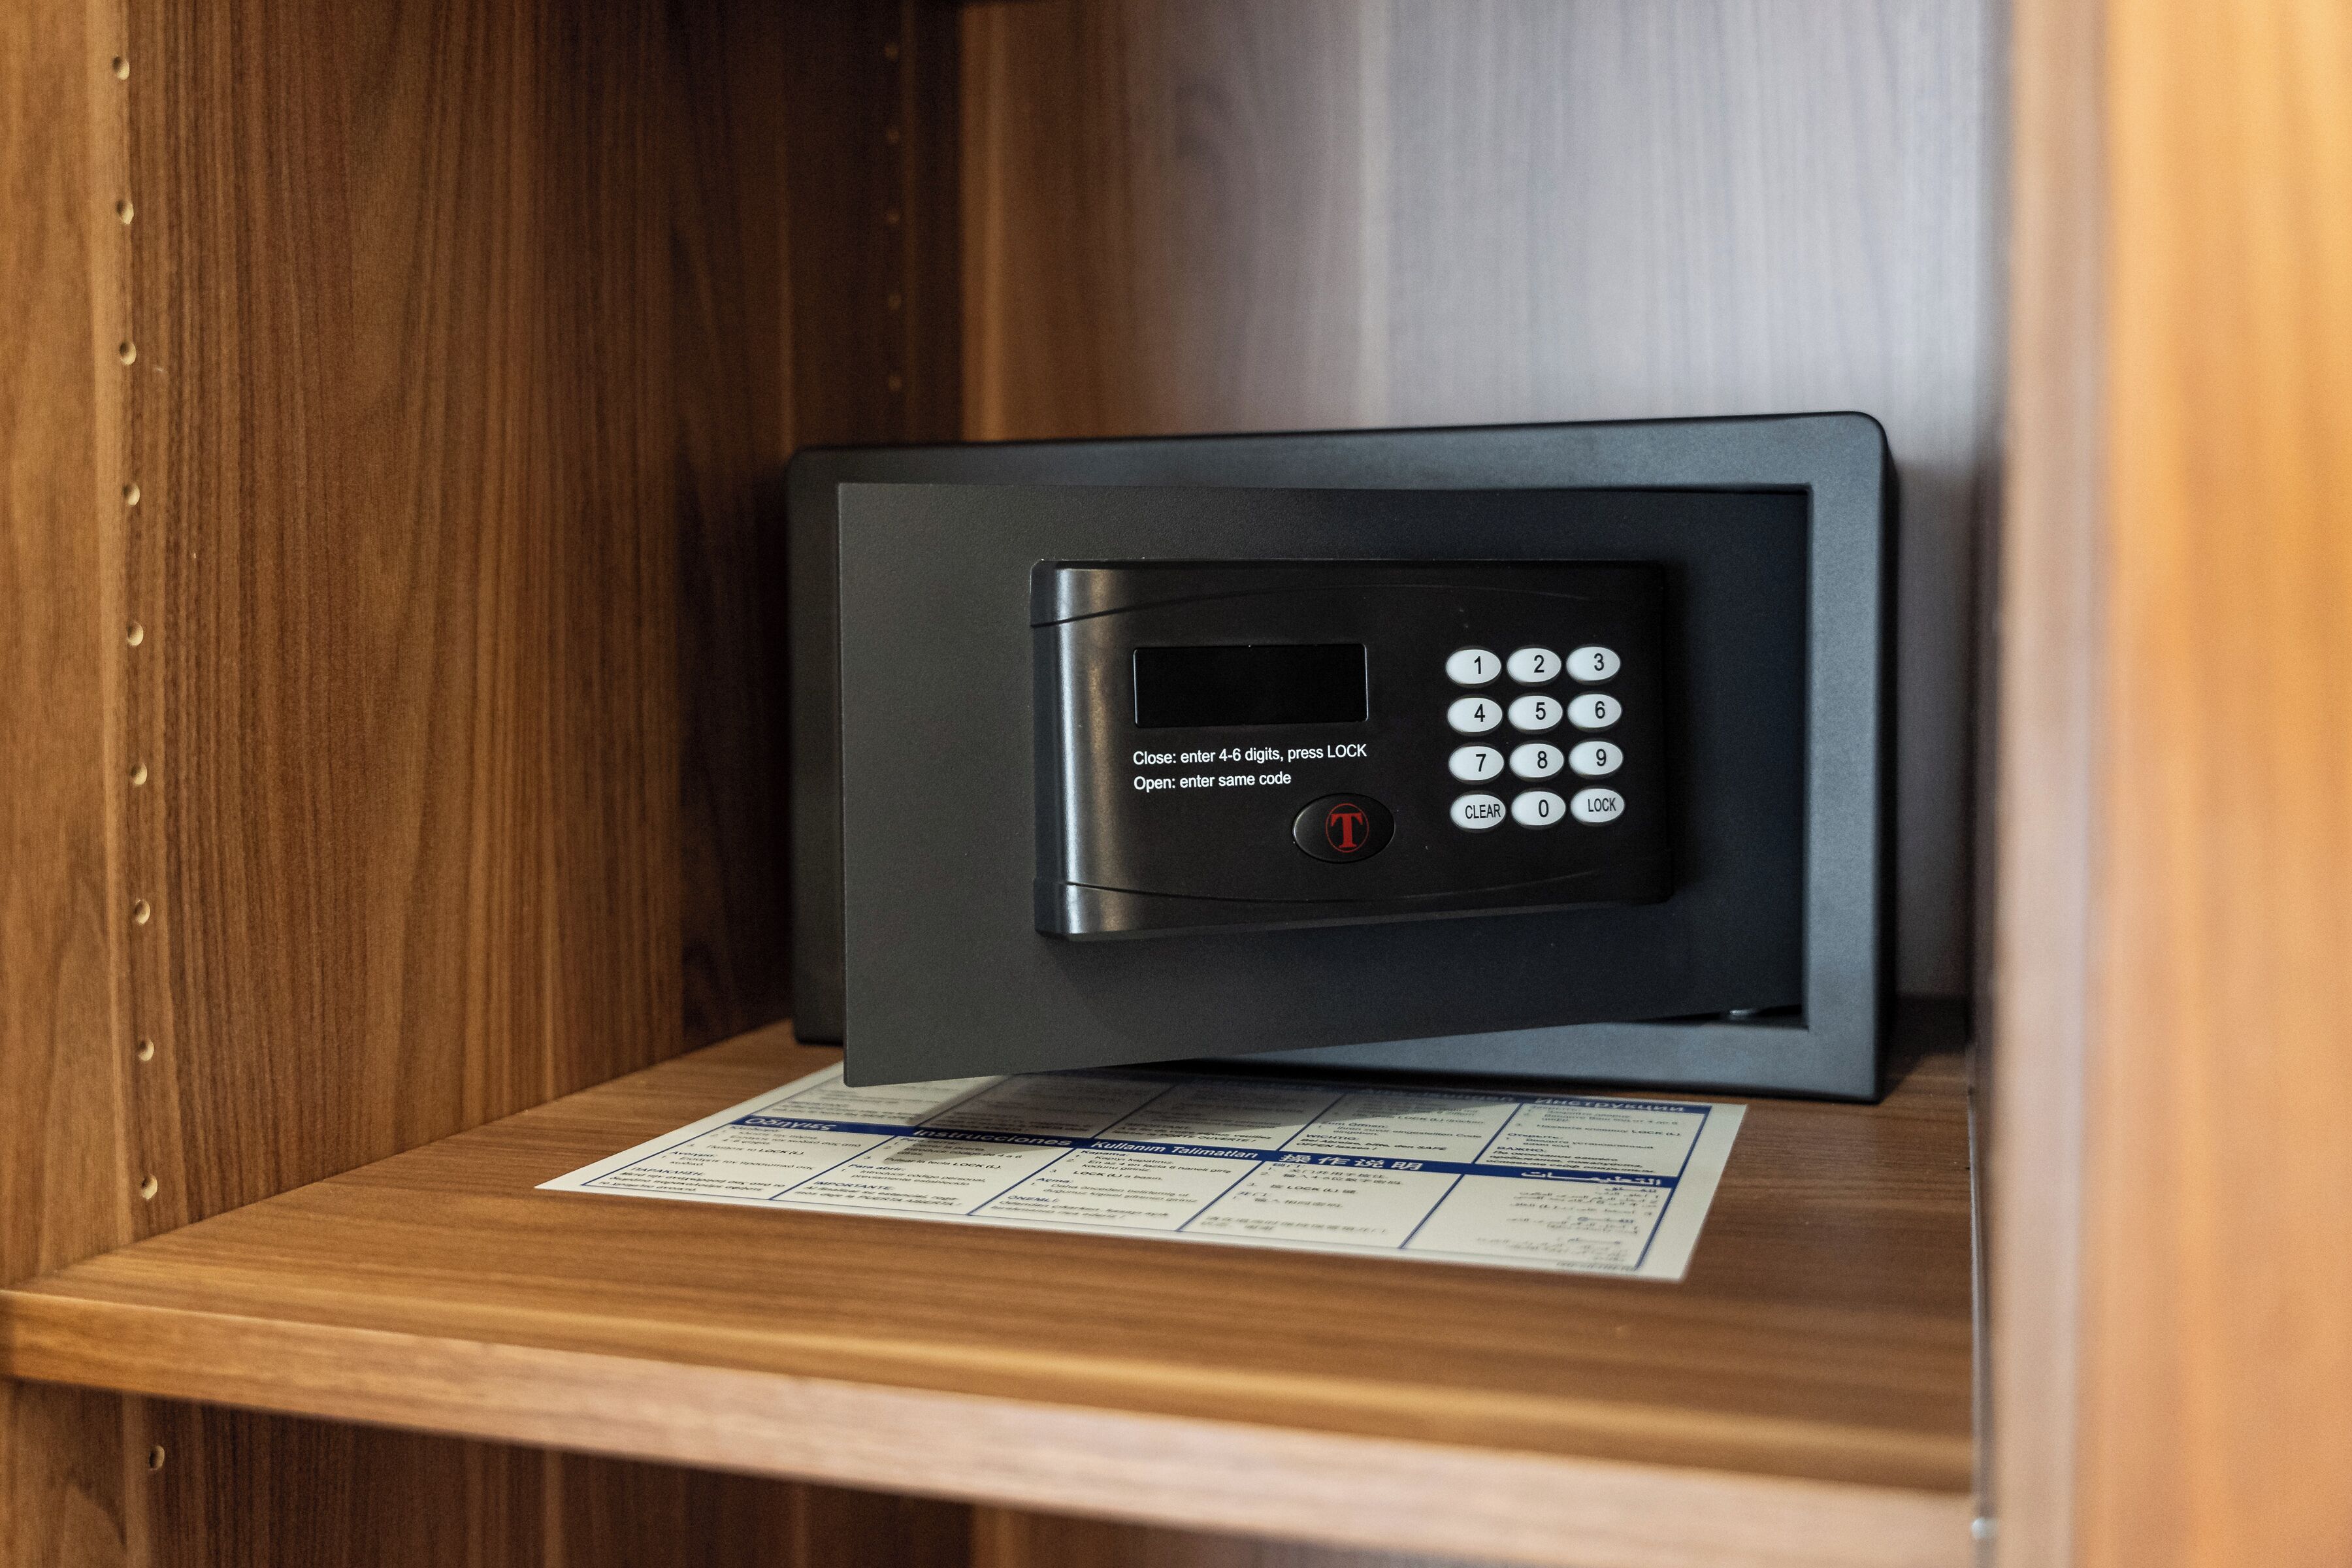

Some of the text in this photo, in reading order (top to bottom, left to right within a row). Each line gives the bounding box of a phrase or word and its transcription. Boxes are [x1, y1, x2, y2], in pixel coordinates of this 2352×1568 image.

[1474, 653, 1605, 675] 1 2 3
[1474, 700, 1605, 722] 4 5 6
[1133, 744, 1367, 766] Close: enter 4-6 digits, press LOCK
[1475, 749, 1607, 772] 7 8 9
[1134, 772, 1292, 792] Open: enter same code
[1465, 798, 1616, 819] CLEAR 0 LOCK
[1330, 811, 1363, 849] T
[1534, 1098, 1684, 1111] Инструкции
[913, 1130, 1073, 1146] Instrucciones
[1091, 1141, 1258, 1158] Kullanım Talimatları
[1279, 1154, 1424, 1170] 操作说明
